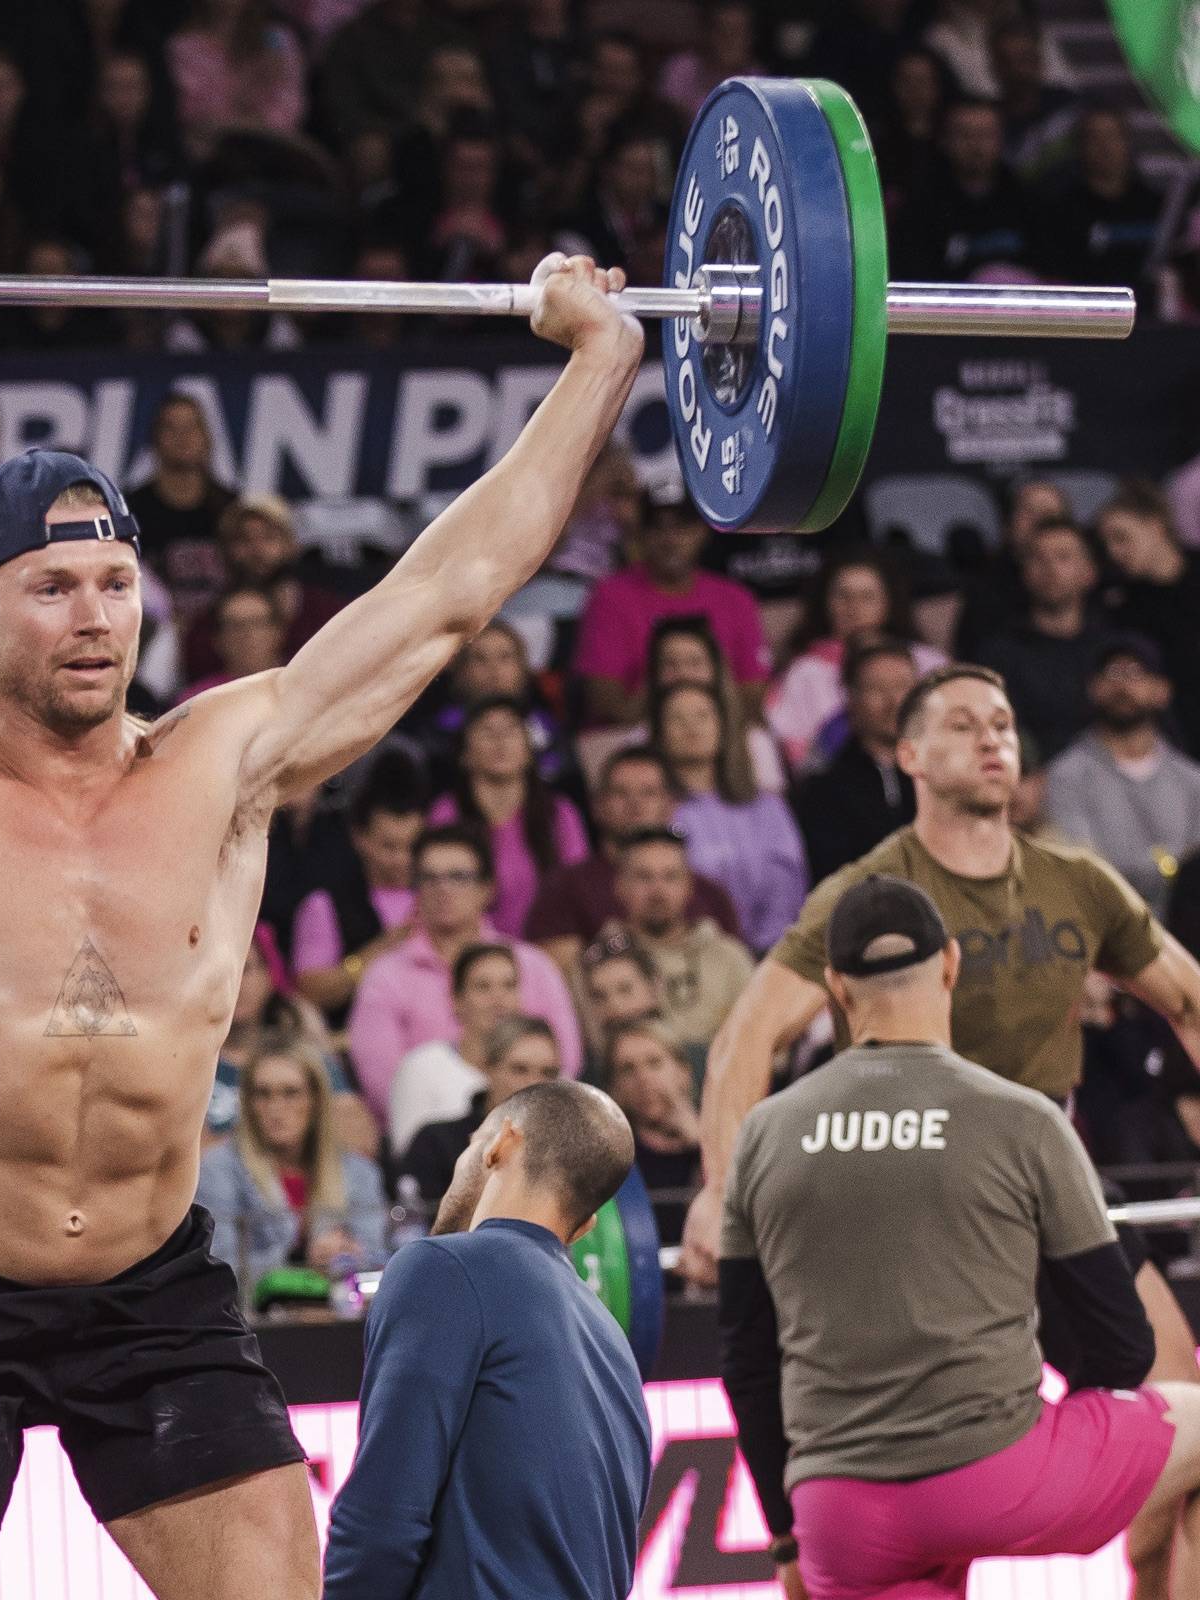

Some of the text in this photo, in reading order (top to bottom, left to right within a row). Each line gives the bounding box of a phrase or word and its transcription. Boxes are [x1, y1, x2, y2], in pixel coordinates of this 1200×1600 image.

[724, 115, 740, 175] 45
[749, 136, 789, 437] ROGUE
[674, 171, 712, 472] ROGUE
[721, 436, 736, 494] 45
[801, 1109, 950, 1154] JUDGE
